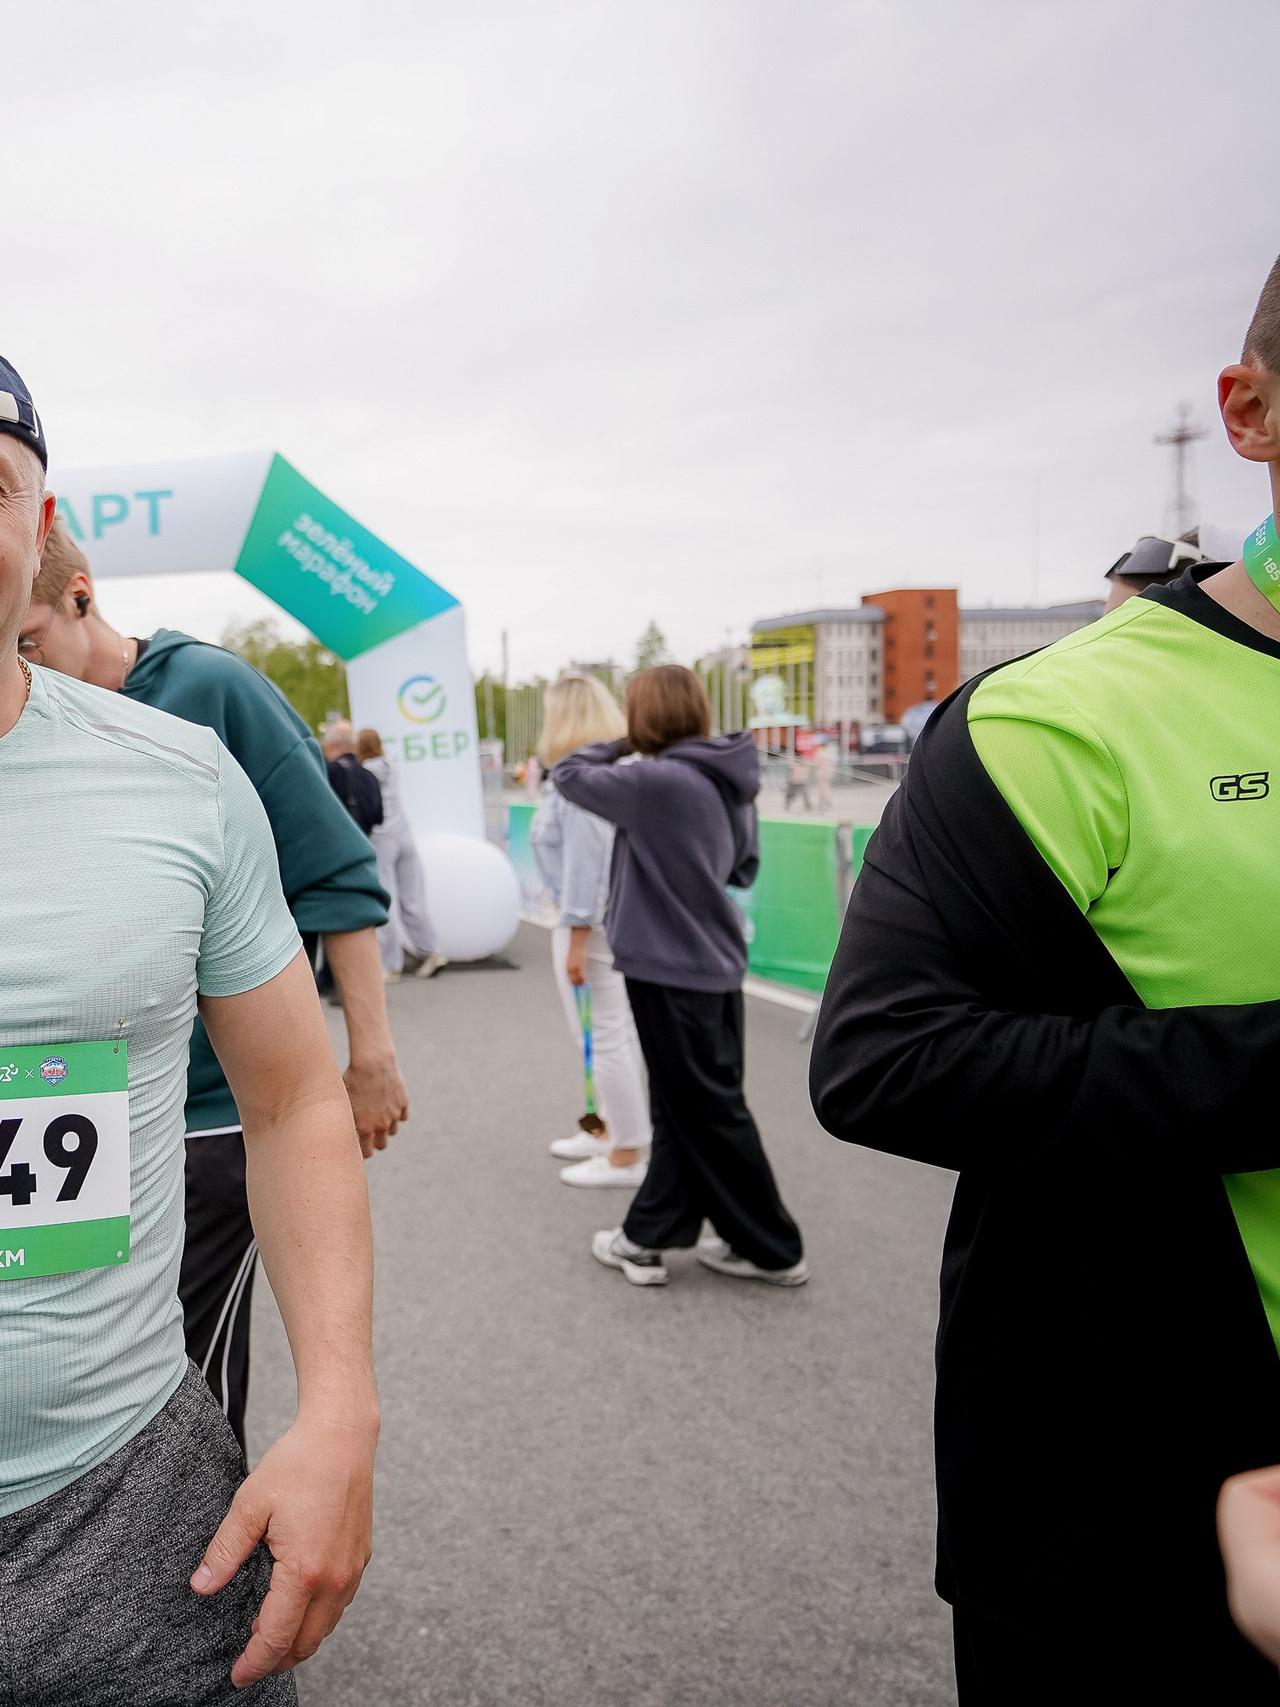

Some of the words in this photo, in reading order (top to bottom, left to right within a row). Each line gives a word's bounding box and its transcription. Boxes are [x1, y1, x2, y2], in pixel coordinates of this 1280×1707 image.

[277, 529, 379, 616] марафон
[293, 511, 396, 598] зелёный
[1209, 771, 1270, 802] GS
